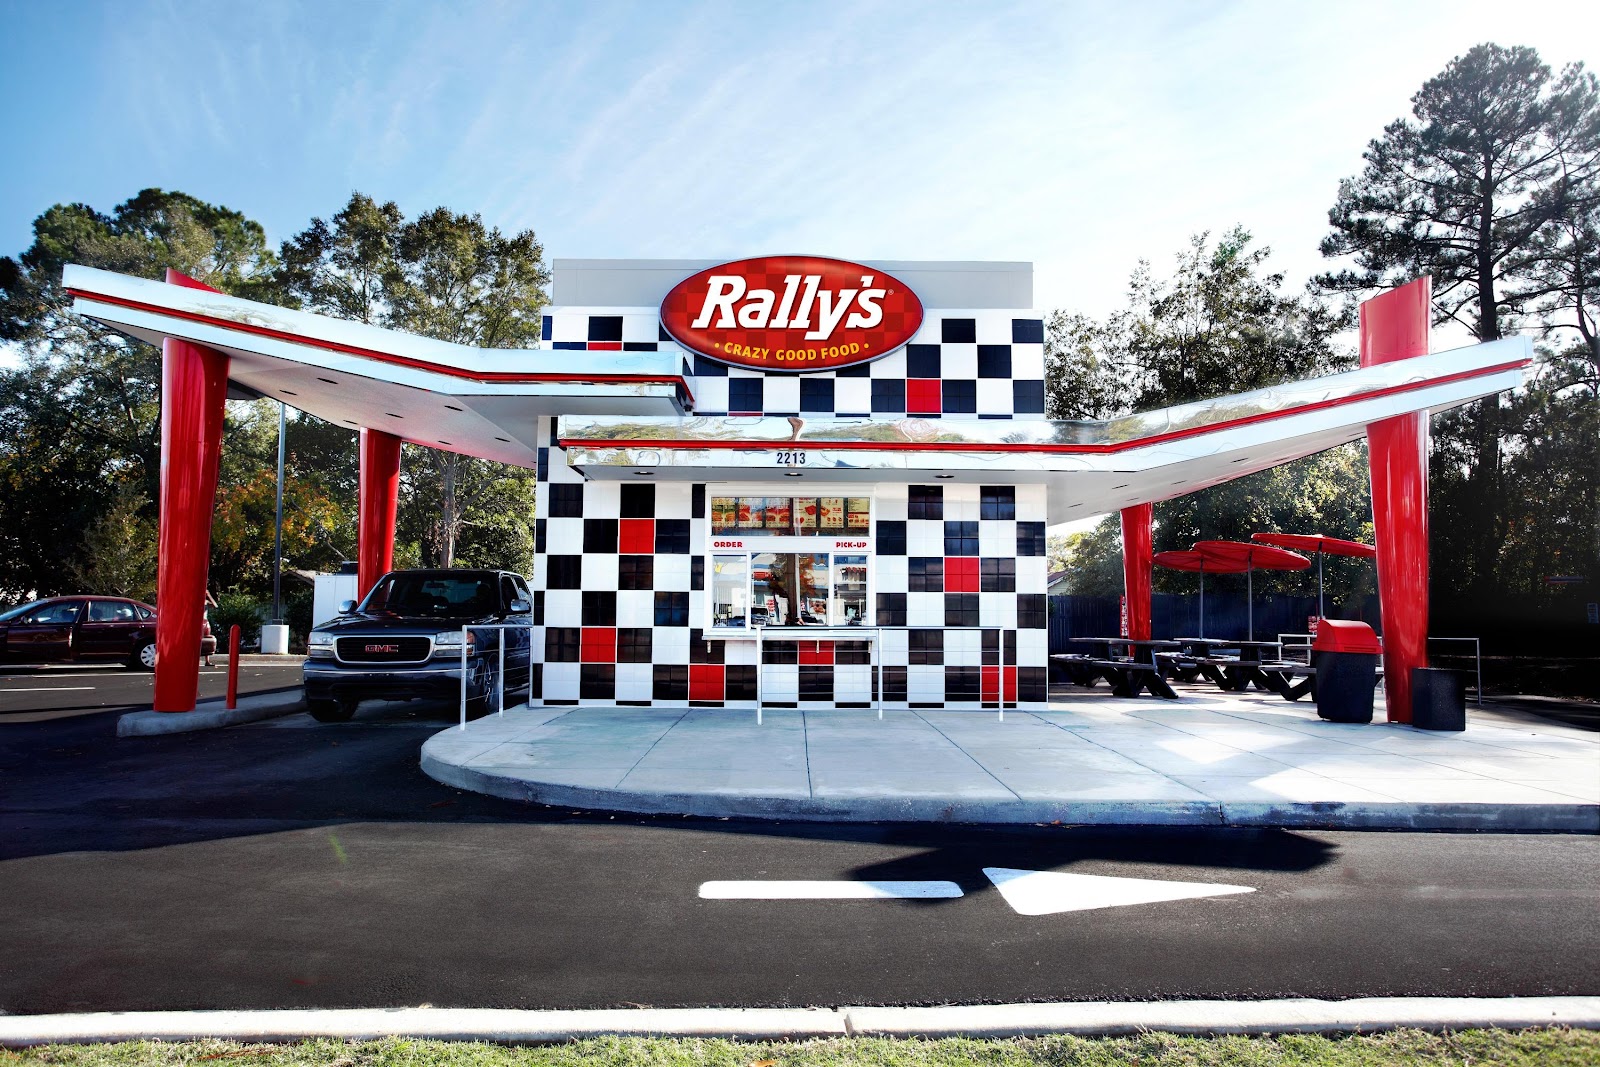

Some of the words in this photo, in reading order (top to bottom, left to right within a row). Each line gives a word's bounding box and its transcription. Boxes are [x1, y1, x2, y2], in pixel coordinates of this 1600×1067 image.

[691, 275, 886, 340] Rally's
[724, 342, 769, 360] CRAZY
[775, 348, 817, 361] GOOD
[821, 342, 860, 360] FOOD
[776, 452, 806, 464] 2213
[366, 644, 399, 653] GMC
